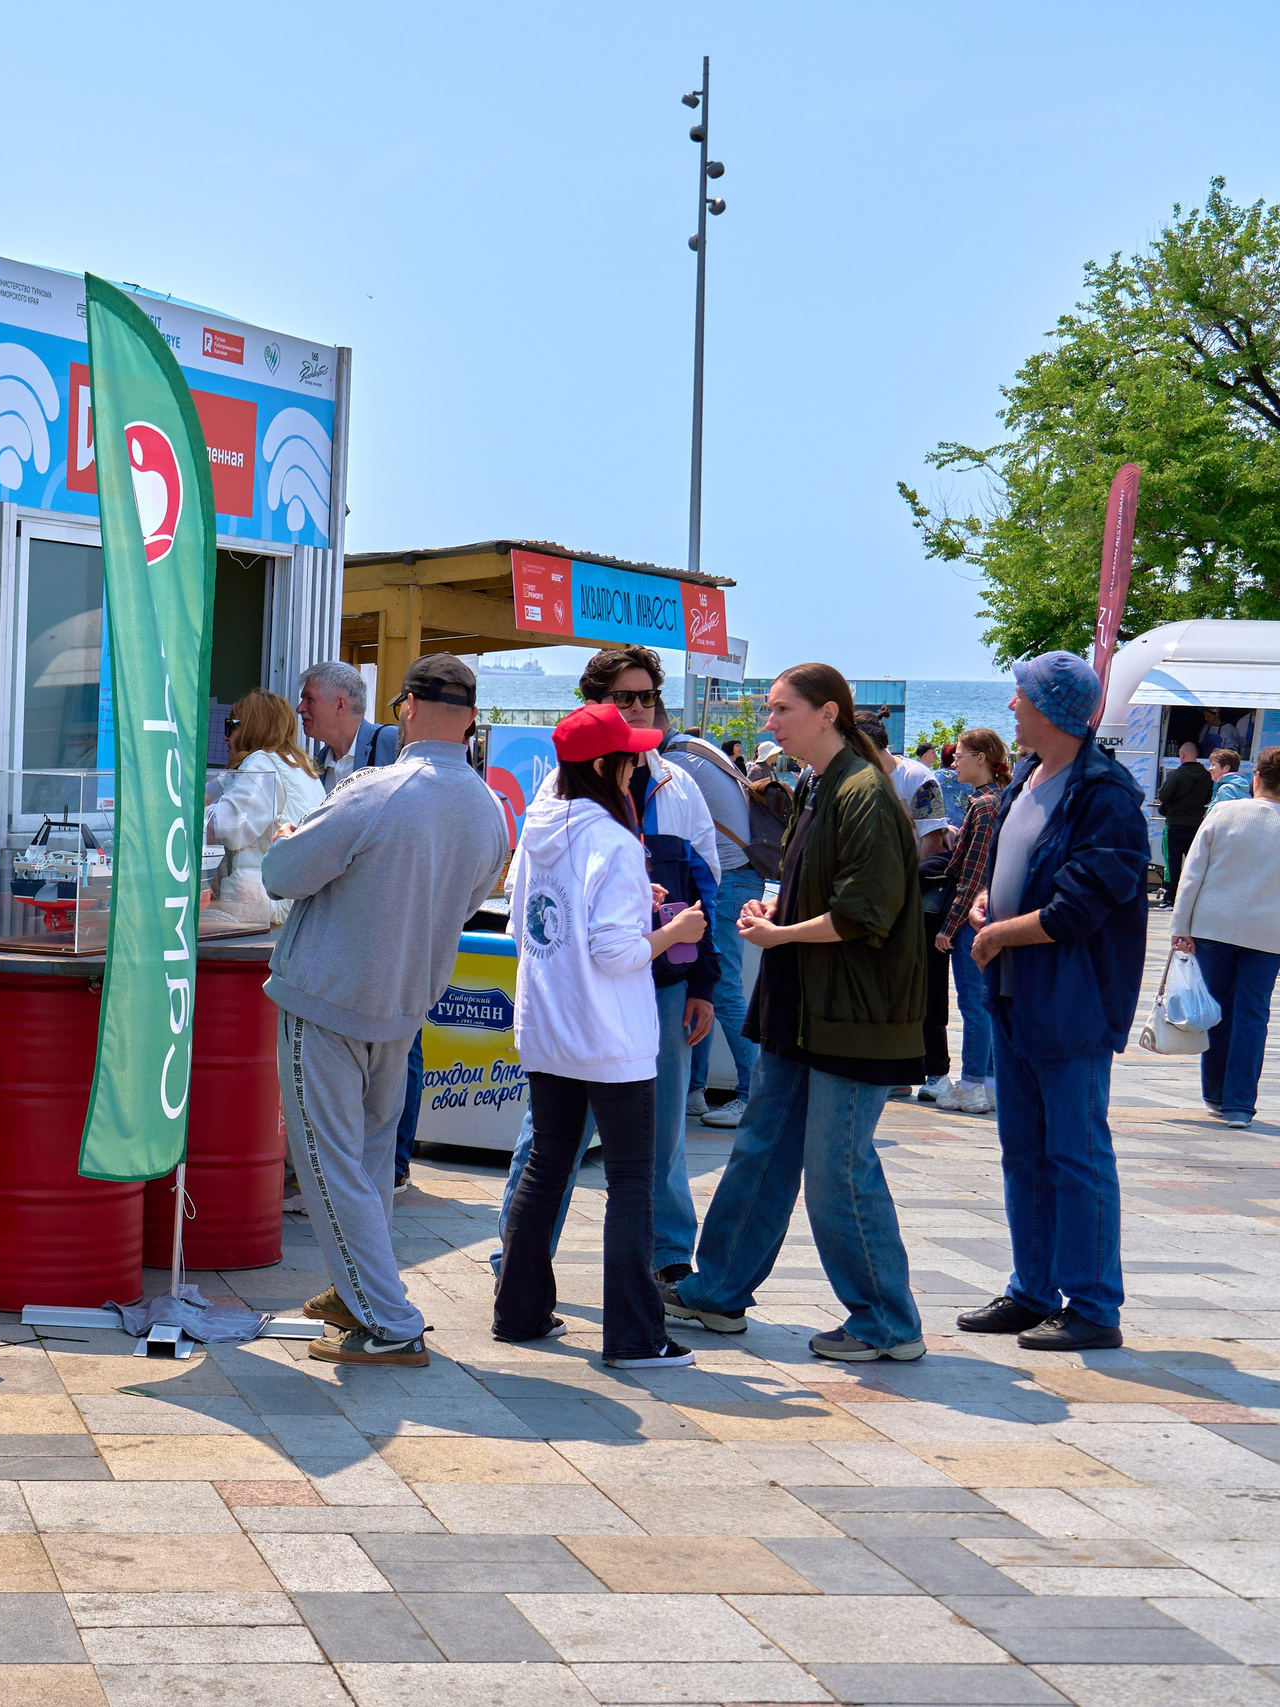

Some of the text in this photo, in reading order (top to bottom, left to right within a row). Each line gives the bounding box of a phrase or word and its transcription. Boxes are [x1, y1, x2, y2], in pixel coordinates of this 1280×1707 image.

[27, 297, 39, 306] КРАЯ
[31, 286, 52, 299] ТУРИЗМА
[580, 583, 632, 626] АКВАПРОМ
[699, 593, 708, 607] 165
[448, 993, 491, 1004] Сибирский
[437, 1002, 503, 1020] ГУРМАН
[431, 1087, 468, 1110] свой
[306, 1129, 316, 1151] ЗАБЕЙ!
[310, 1152, 322, 1175] ЗАБЕЙ!
[324, 1198, 336, 1221] ЗАБЕЙ!
[331, 1221, 344, 1244] ЗАБЕЙ!
[340, 1244, 353, 1266] ЗАБЕЙ!
[347, 1267, 360, 1290] ЗАБЕЙ!
[355, 1290, 369, 1312] ЗАБЕЙ!
